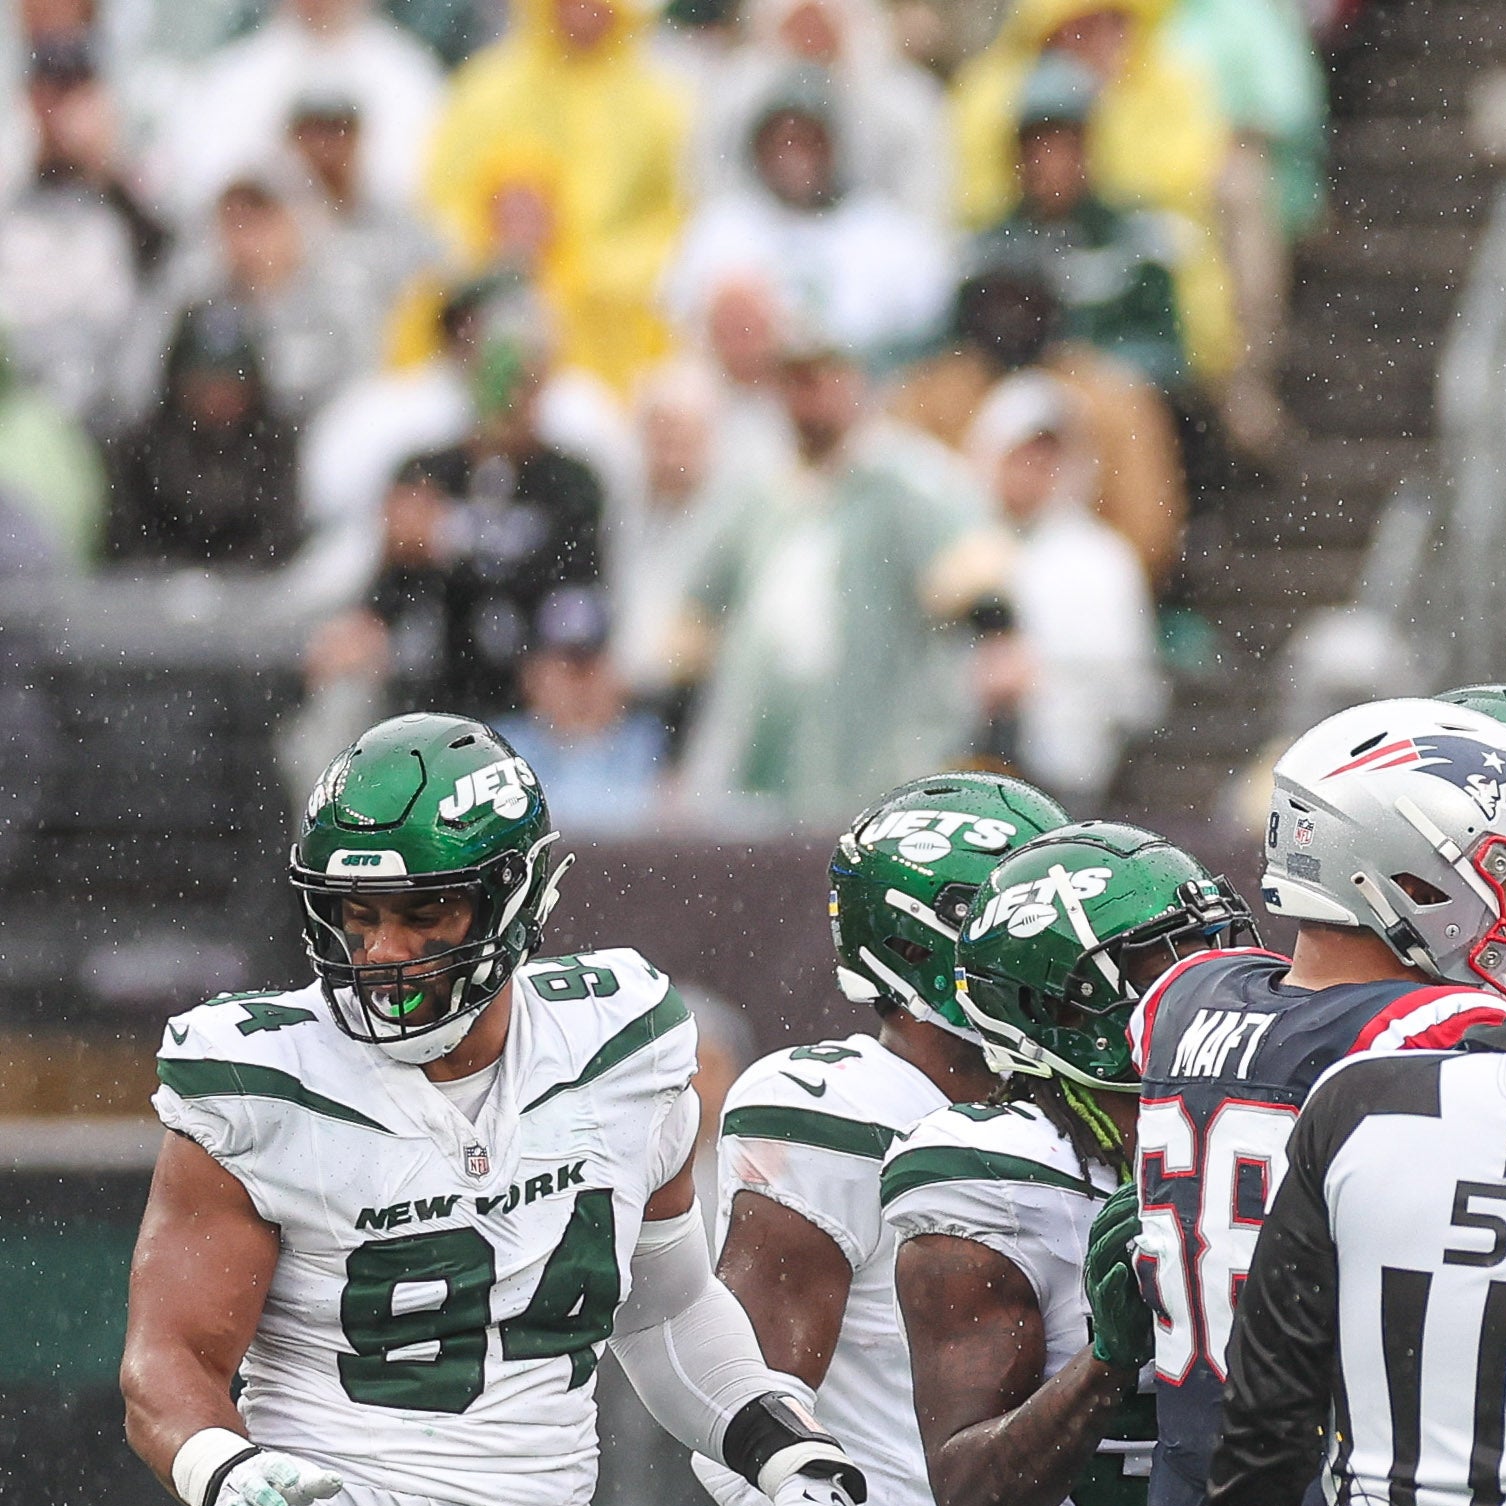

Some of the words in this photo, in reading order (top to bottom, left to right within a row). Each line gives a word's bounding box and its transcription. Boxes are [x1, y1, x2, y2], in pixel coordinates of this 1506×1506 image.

[439, 757, 536, 820] JETS
[341, 854, 381, 867] JETS
[860, 810, 1017, 850] JETS
[1170, 1009, 1278, 1080] MAFI
[355, 1195, 462, 1230] NEW
[475, 1159, 587, 1216] YORK
[1133, 1096, 1300, 1387] 68
